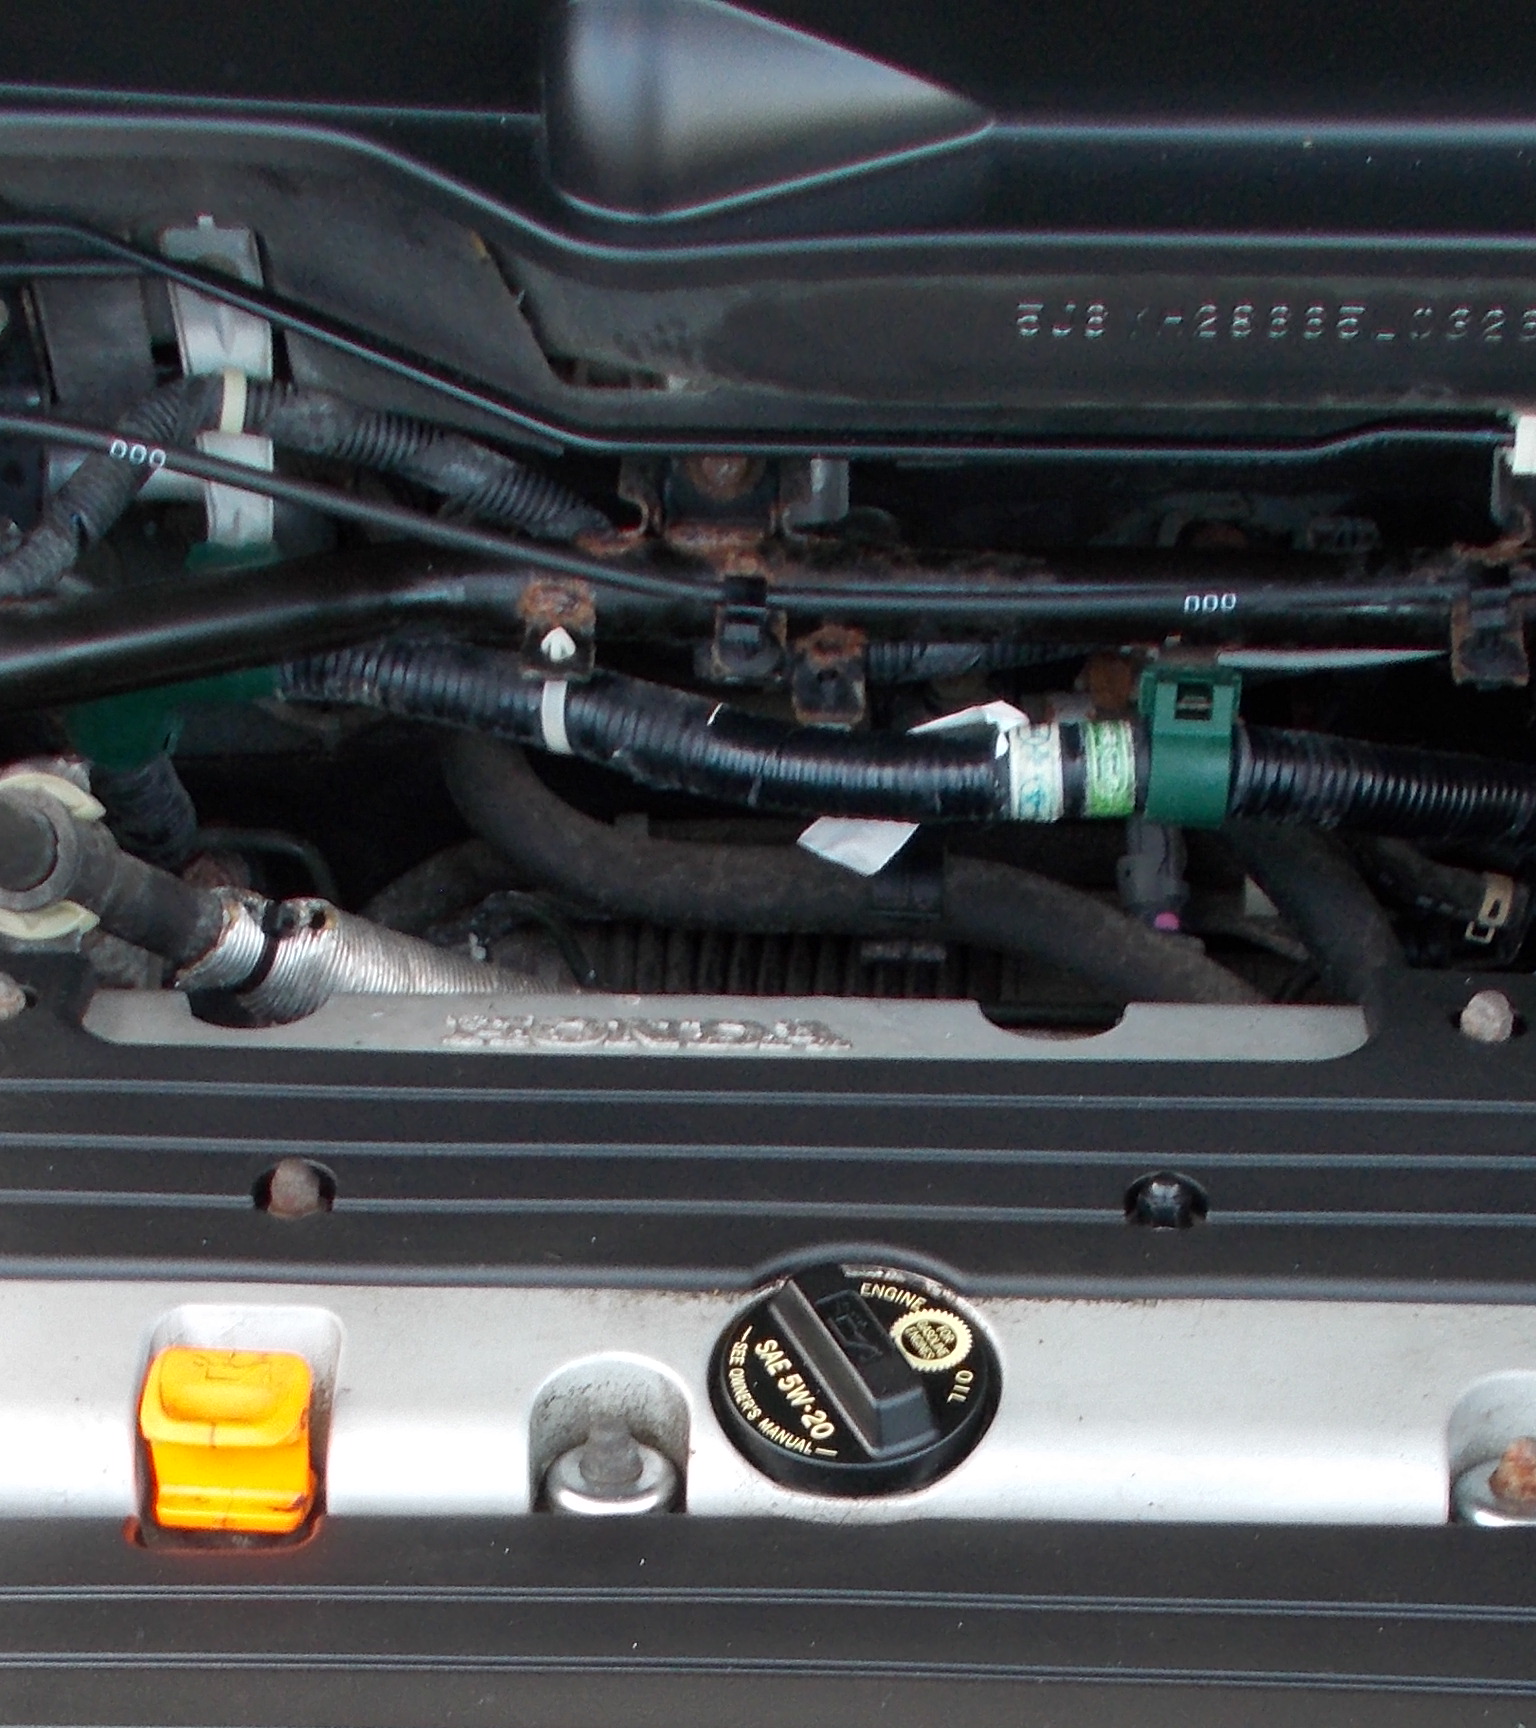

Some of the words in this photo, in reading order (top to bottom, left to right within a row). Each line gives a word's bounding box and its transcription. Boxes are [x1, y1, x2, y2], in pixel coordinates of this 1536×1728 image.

[860, 1281, 928, 1313] ENGINE
[754, 1338, 792, 1376] SAE
[728, 1341, 749, 1366] SEE
[758, 1418, 814, 1456] MANUAL
[946, 1368, 975, 1404] OIL
